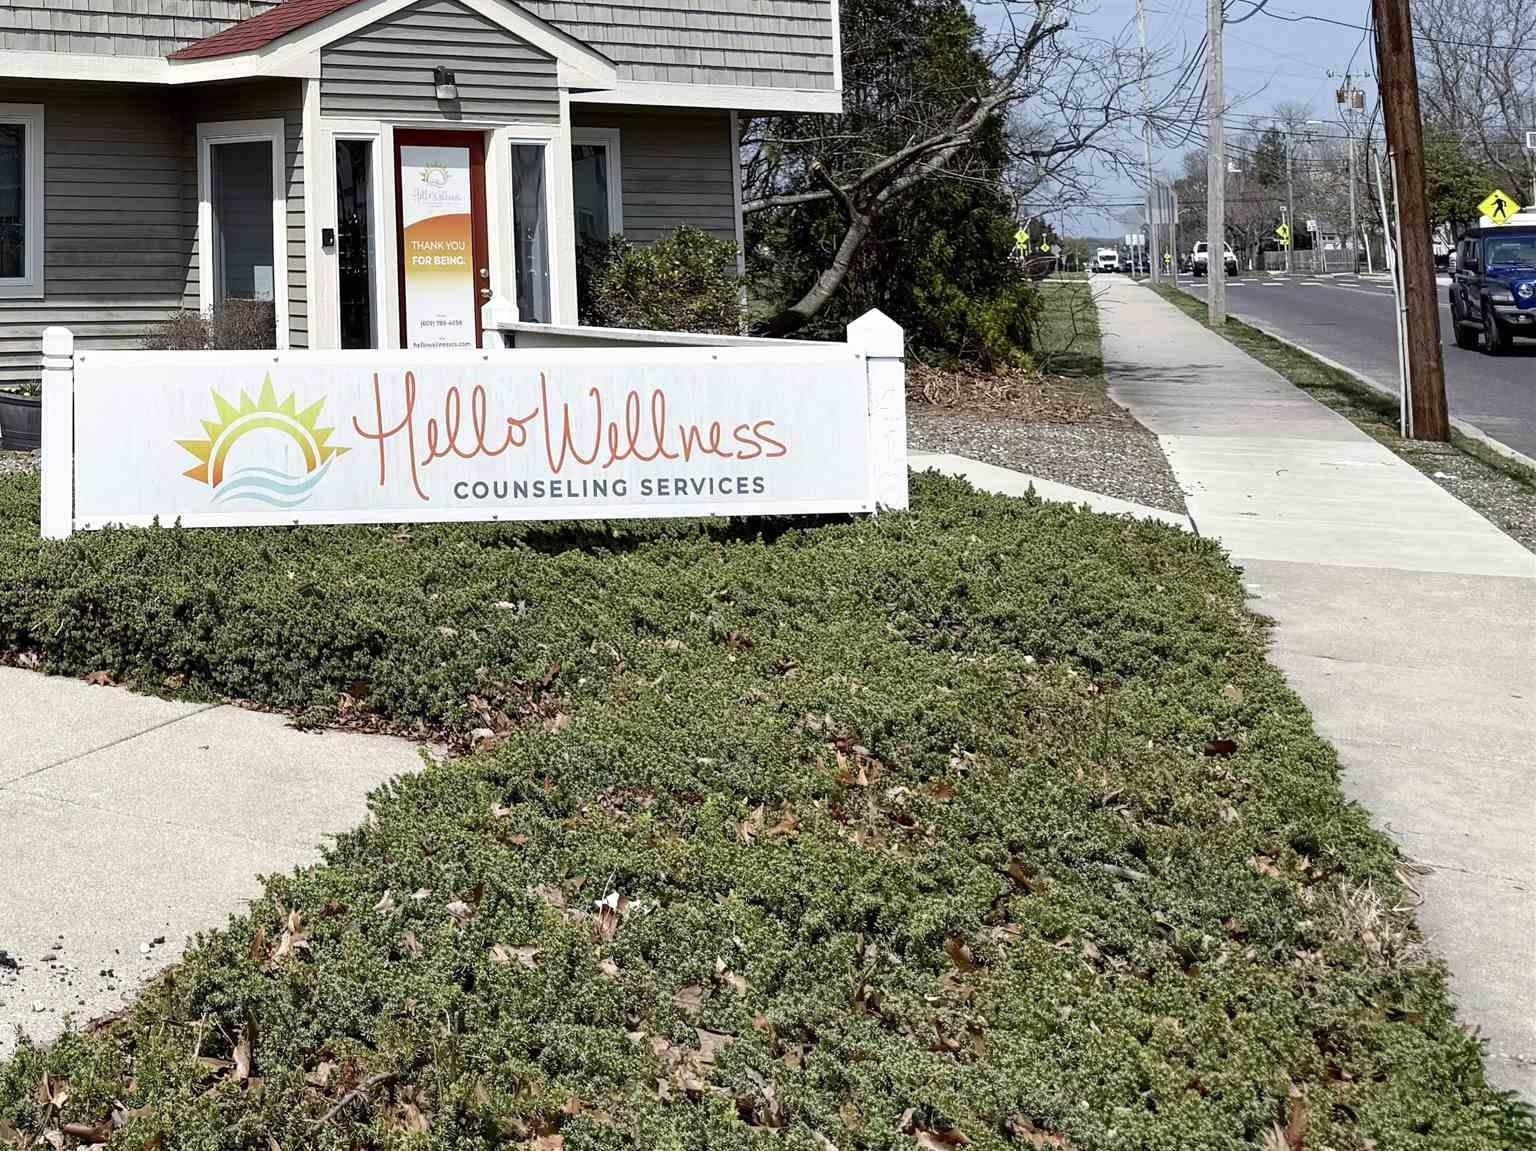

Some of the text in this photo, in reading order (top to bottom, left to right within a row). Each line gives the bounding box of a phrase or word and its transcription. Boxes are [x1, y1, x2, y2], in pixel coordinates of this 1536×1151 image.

[411, 240, 465, 250] THANK YOU
[412, 255, 466, 265] FOR BEING.
[352, 370, 788, 501] Hello Wellness
[453, 476, 766, 499] COUNSELING SERVICES
